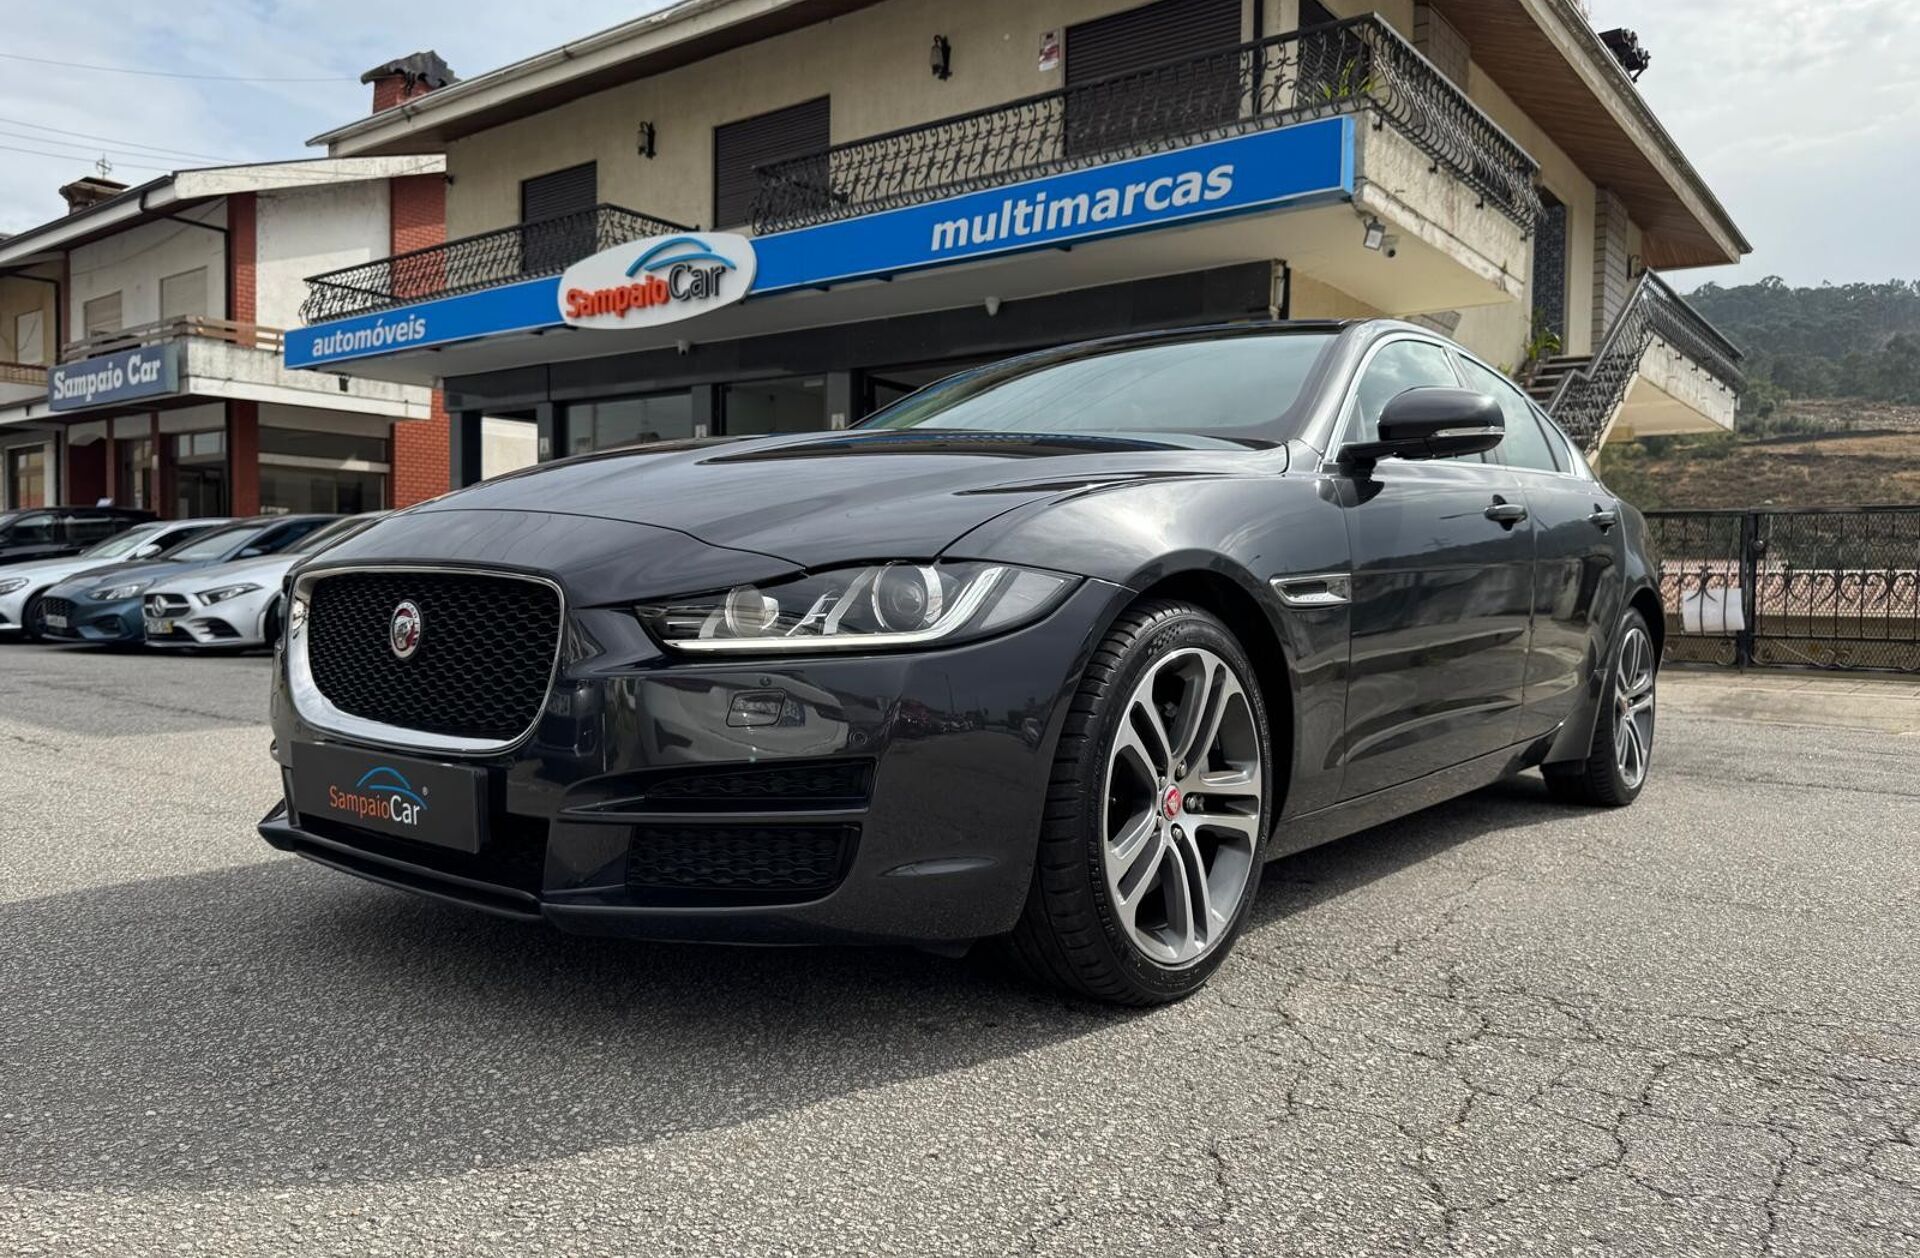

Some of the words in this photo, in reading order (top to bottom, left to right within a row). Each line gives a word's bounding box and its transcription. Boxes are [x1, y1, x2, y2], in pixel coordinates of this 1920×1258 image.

[931, 164, 1235, 251] multimarcas
[566, 263, 727, 319] SampaioCar
[312, 314, 427, 357] automóveis
[53, 361, 123, 402] Sampaio
[127, 354, 161, 385] Car
[329, 785, 420, 825] SampaioCar
